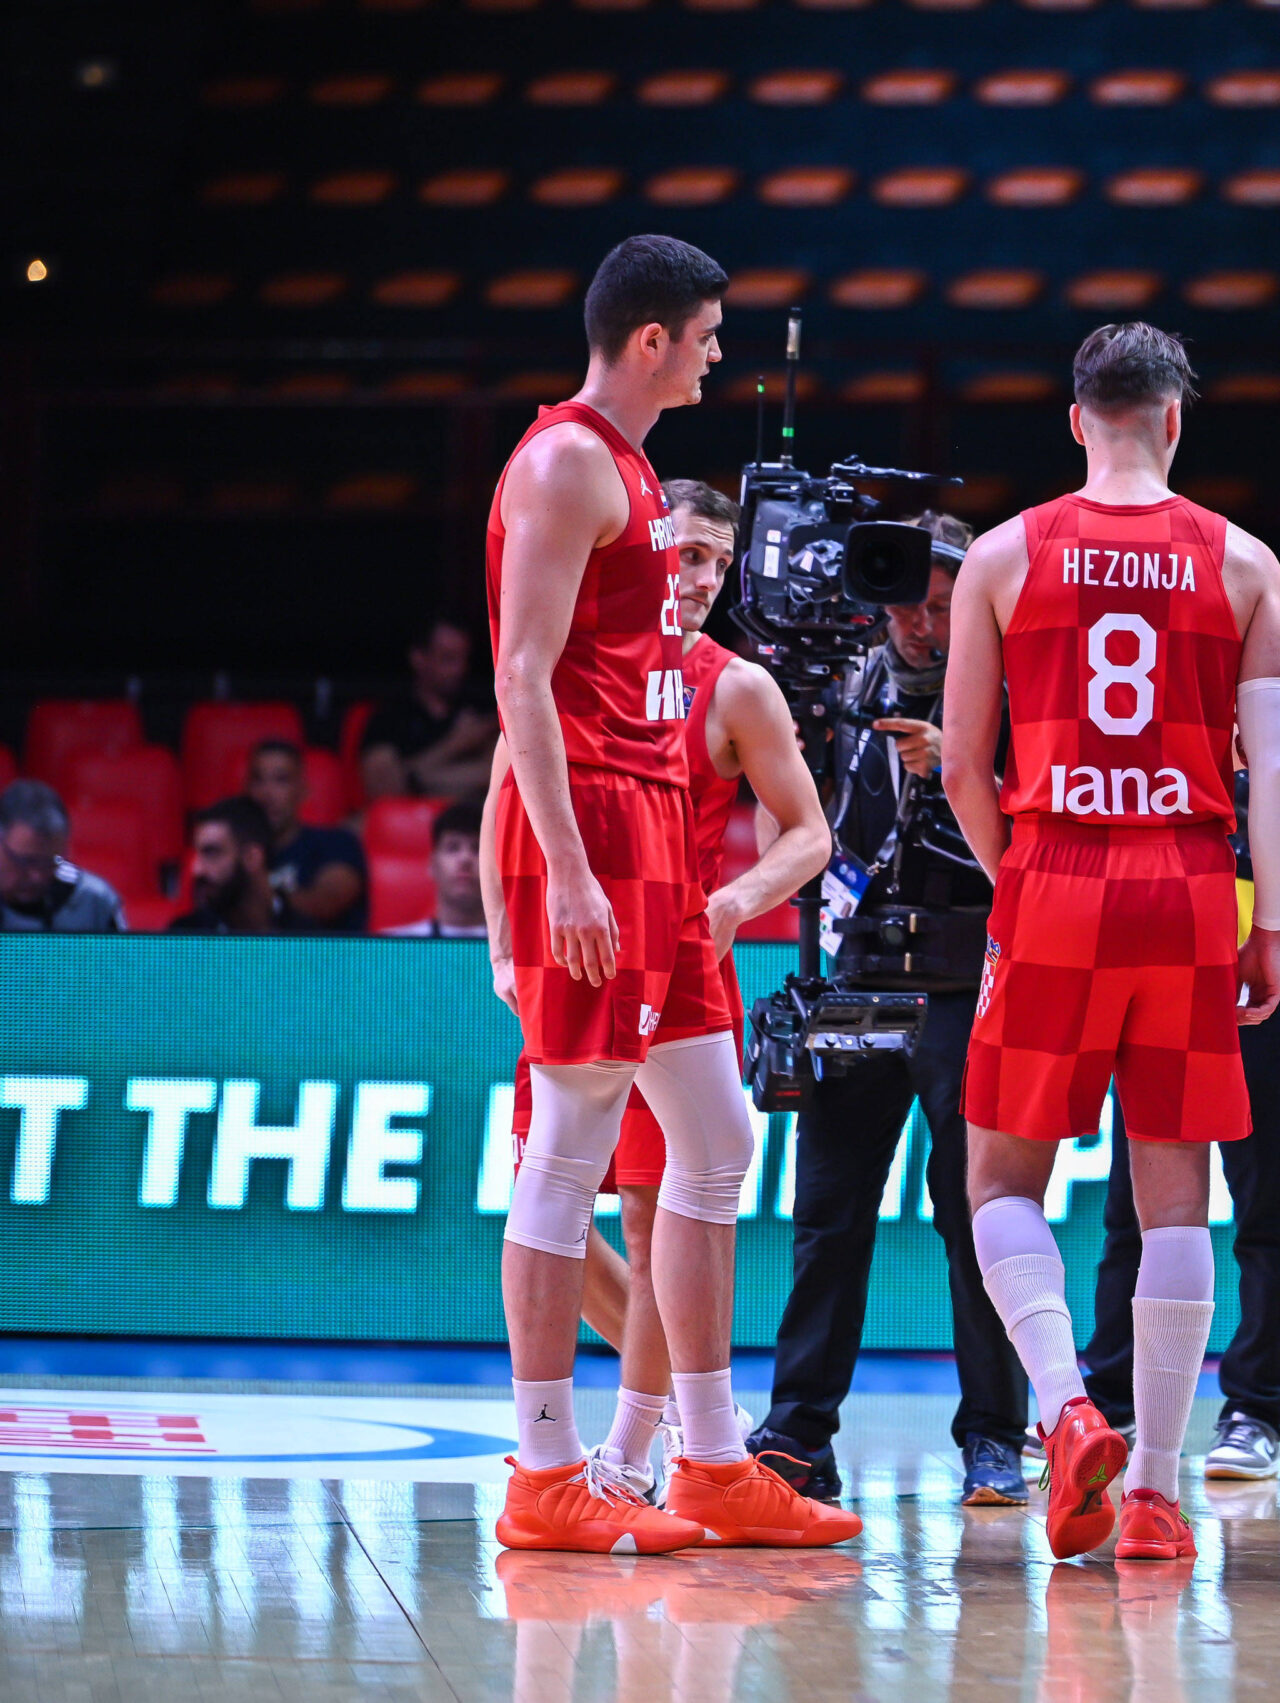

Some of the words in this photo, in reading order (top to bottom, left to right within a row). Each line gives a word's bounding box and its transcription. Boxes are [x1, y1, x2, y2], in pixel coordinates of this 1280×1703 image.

[1063, 547, 1196, 592] HEZONJA
[1087, 612, 1157, 736] 8
[126, 1077, 432, 1212] THE
